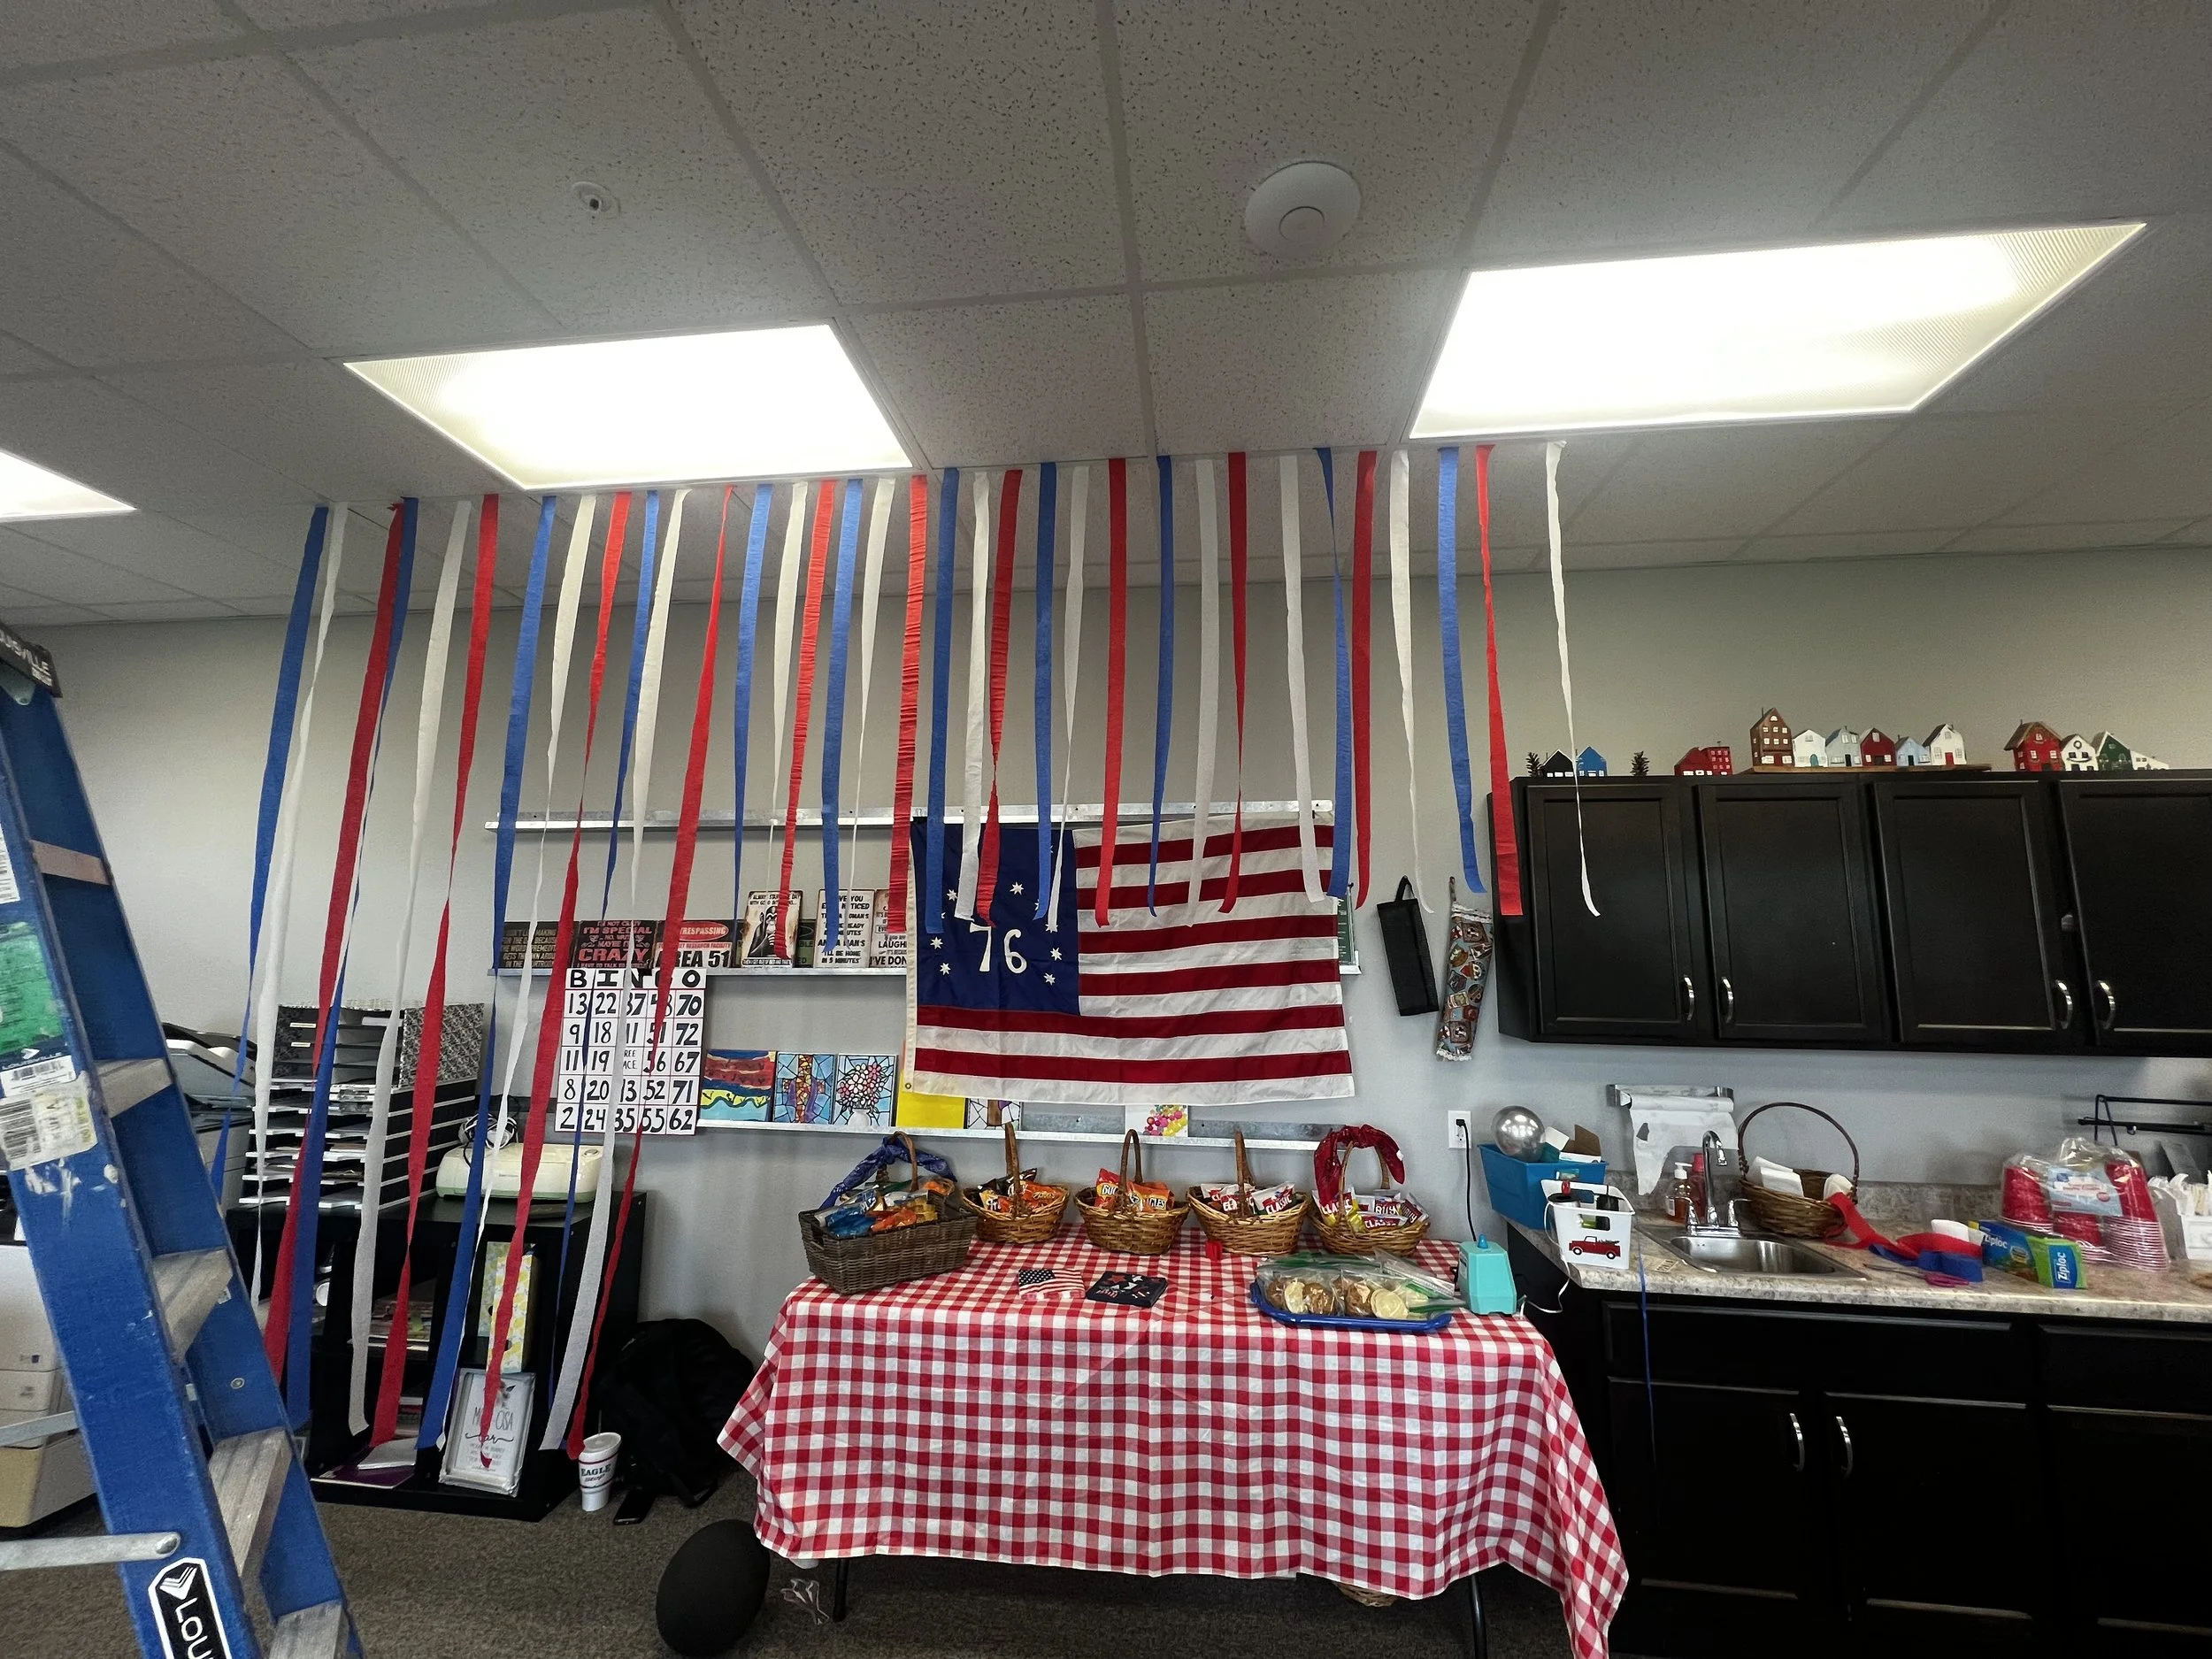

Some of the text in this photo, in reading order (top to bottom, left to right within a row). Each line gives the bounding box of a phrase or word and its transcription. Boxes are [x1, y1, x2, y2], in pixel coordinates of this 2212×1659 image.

[579, 949, 649, 962] CRAZY
[708, 950, 730, 967] 51
[969, 922, 1027, 974] 76
[569, 993, 588, 1015] 13
[595, 993, 617, 1015] 22
[676, 994, 702, 1016] 70
[570, 1024, 580, 1044] 9
[595, 1021, 611, 1044] 18
[676, 1023, 699, 1045] 72
[566, 1050, 610, 1071] 11 19
[623, 1060, 636, 1070] ACE
[643, 1051, 700, 1073] 56 67
[565, 1079, 576, 1100] 8
[587, 1080, 610, 1101] 20
[643, 1079, 665, 1101] 52
[672, 1080, 693, 1104] 71
[560, 1107, 575, 1129] 2
[584, 1109, 606, 1130] 24
[615, 1109, 635, 1132] 35
[670, 1108, 693, 1130] 62
[1265, 1194, 1293, 1215] CLASSIC
[1984, 1234, 2008, 1249] Ziploc
[2057, 1251, 2070, 1280] Ziploc
[472, 1407, 513, 1431] MOSA
[580, 1463, 611, 1476] EAGLE
